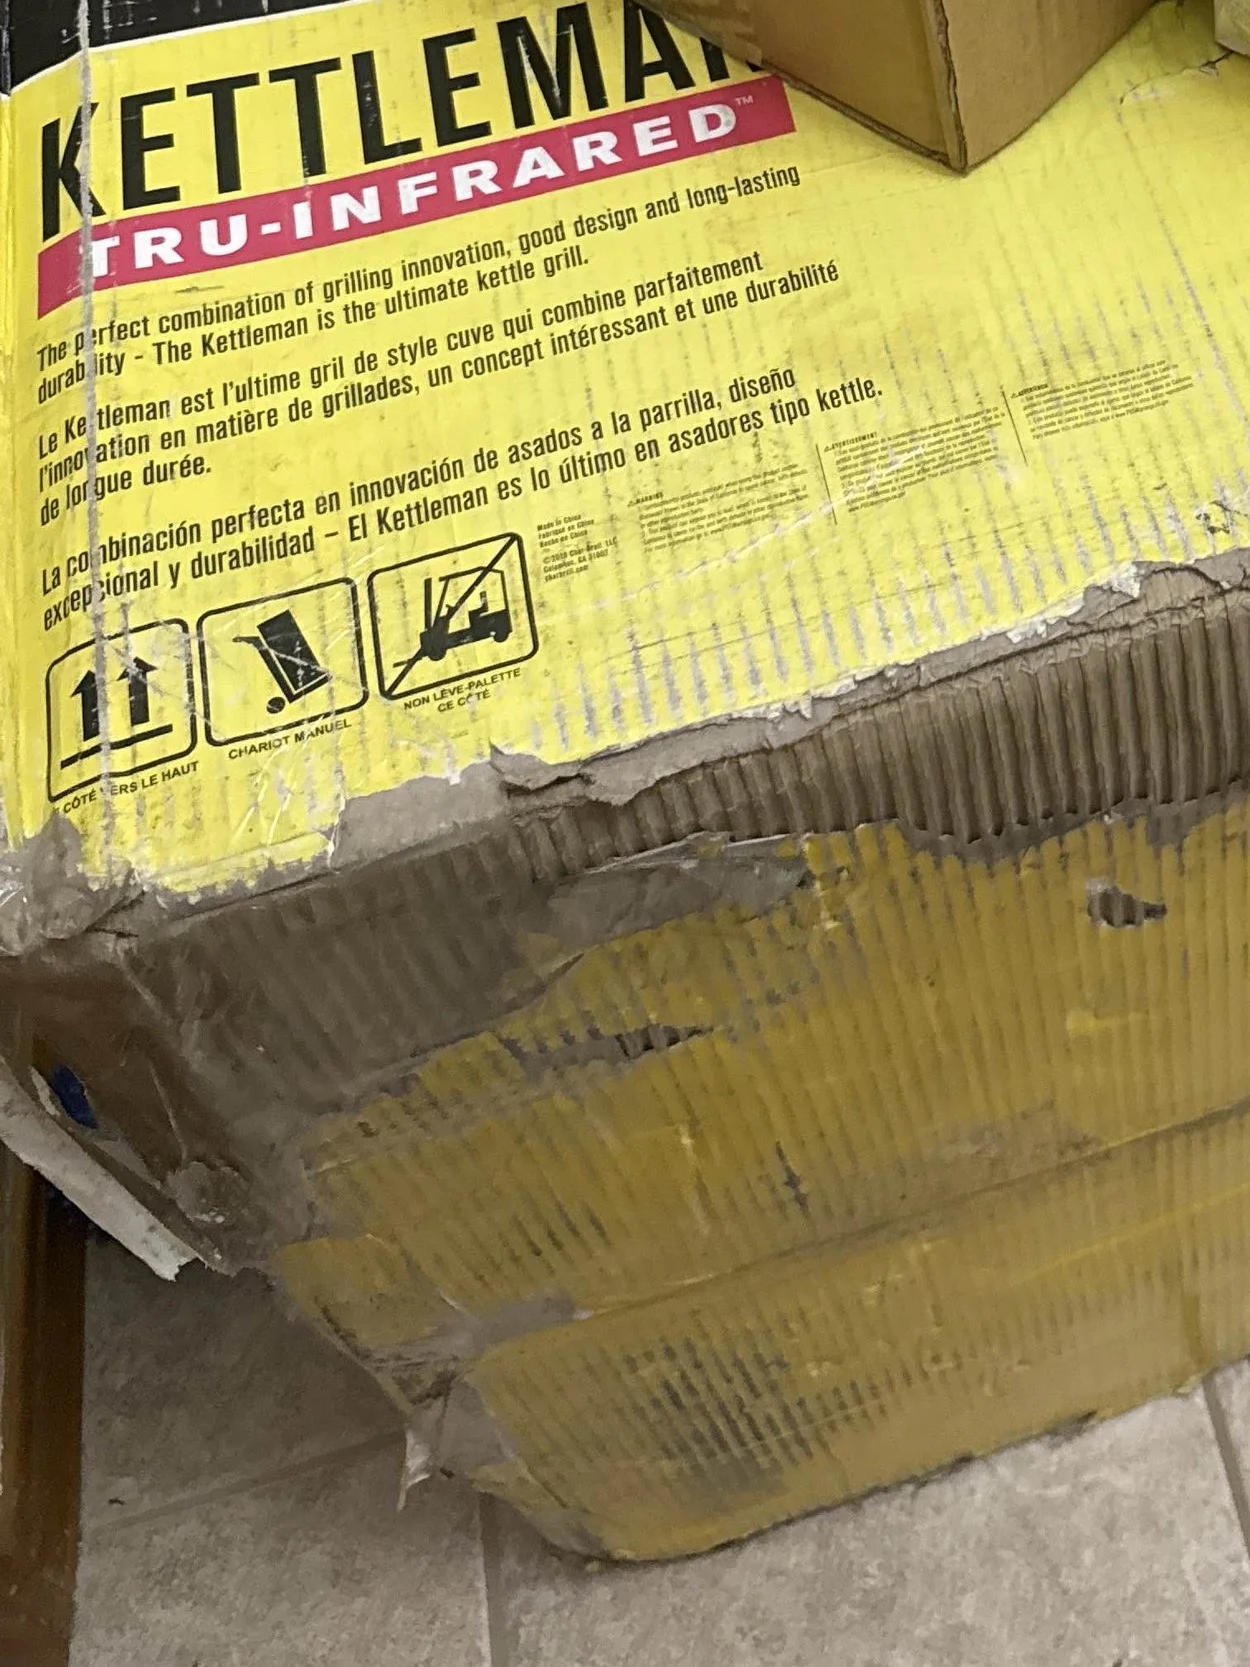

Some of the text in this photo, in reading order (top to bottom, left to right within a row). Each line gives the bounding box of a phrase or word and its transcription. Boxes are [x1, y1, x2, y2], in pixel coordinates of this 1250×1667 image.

[36, 166, 800, 371] The prfect combination of grilling innovation, good design and long-lasting
[38, 245, 588, 404] durablity The Kettleman is the ultimate kettle grill.
[39, 432, 58, 459] Le
[64, 400, 170, 443] Ketleman
[181, 388, 214, 415] est
[310, 356, 344, 389] gril
[354, 350, 378, 374] de
[387, 335, 437, 366] style
[446, 324, 494, 351] cuve
[502, 308, 533, 338] qui
[541, 289, 626, 326] combine
[634, 251, 763, 306] parfaitement
[39, 260, 838, 492] l'innoation en matière de grillades, un concept intéressant et une durabilité
[40, 498, 59, 526] de
[142, 454, 210, 485] durée.
[42, 566, 61, 596] La
[211, 499, 309, 544] perfecta
[315, 491, 340, 515] en
[350, 457, 464, 506] innovación
[473, 447, 498, 473] de
[508, 427, 582, 464] asados
[590, 421, 603, 440] a
[610, 411, 631, 435] la
[639, 389, 721, 432] parrilla,
[728, 368, 795, 402] diseño
[168, 564, 180, 589] y
[191, 526, 314, 578] durabilidad
[348, 513, 367, 542] El
[376, 486, 488, 534] Kettleman
[497, 477, 522, 500] es
[530, 467, 550, 491] lo
[559, 448, 626, 483] último
[634, 439, 660, 462] en
[668, 410, 763, 452] asadores
[769, 397, 810, 424] tipo
[816, 377, 882, 411] kettle.
[228, 719, 352, 759] CHARIOT MANUEL
[404, 695, 431, 710] NON
[438, 701, 454, 713] CE
[63, 760, 199, 814] CÔTÉ ERS LE HAUT
